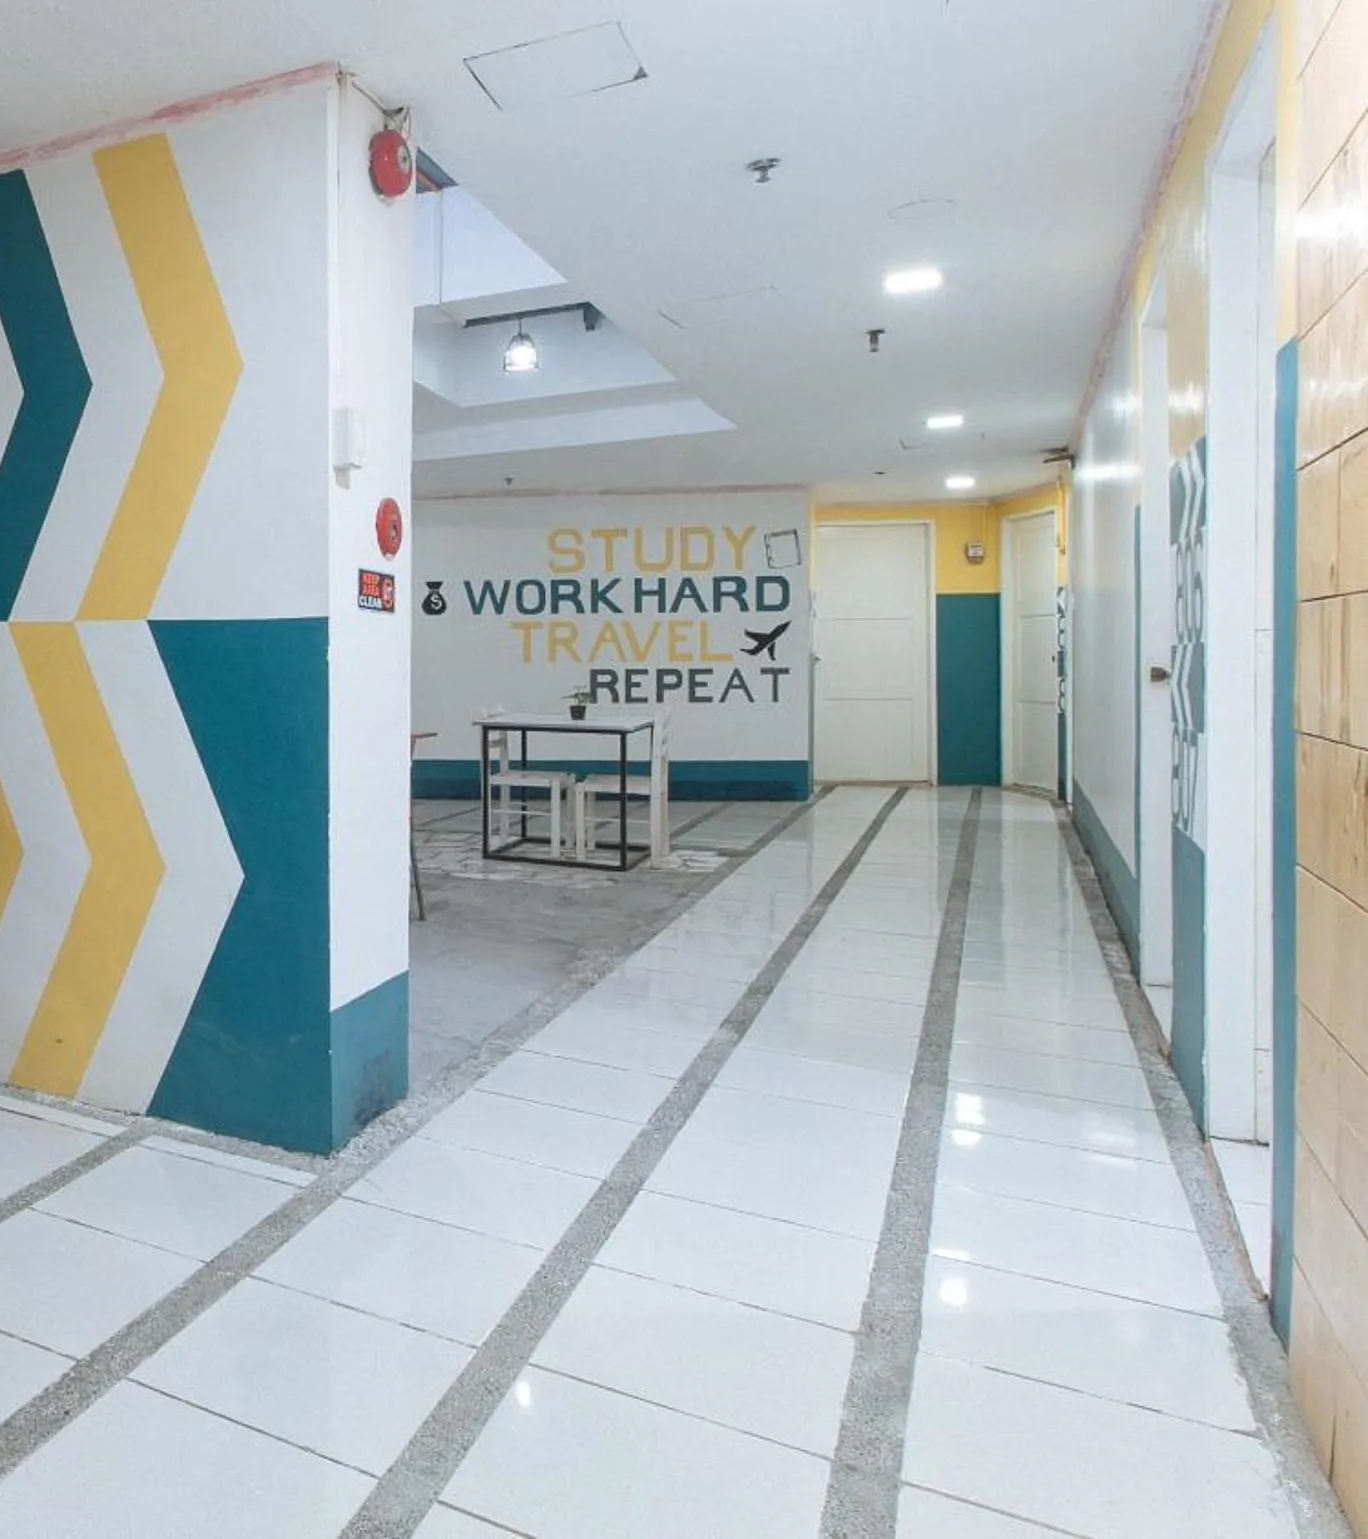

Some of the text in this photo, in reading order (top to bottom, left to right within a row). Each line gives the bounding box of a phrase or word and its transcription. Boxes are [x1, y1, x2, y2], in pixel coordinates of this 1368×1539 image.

[546, 525, 757, 573] STUDY
[509, 620, 733, 664] TRAVEL
[589, 667, 790, 704] REPEAT
